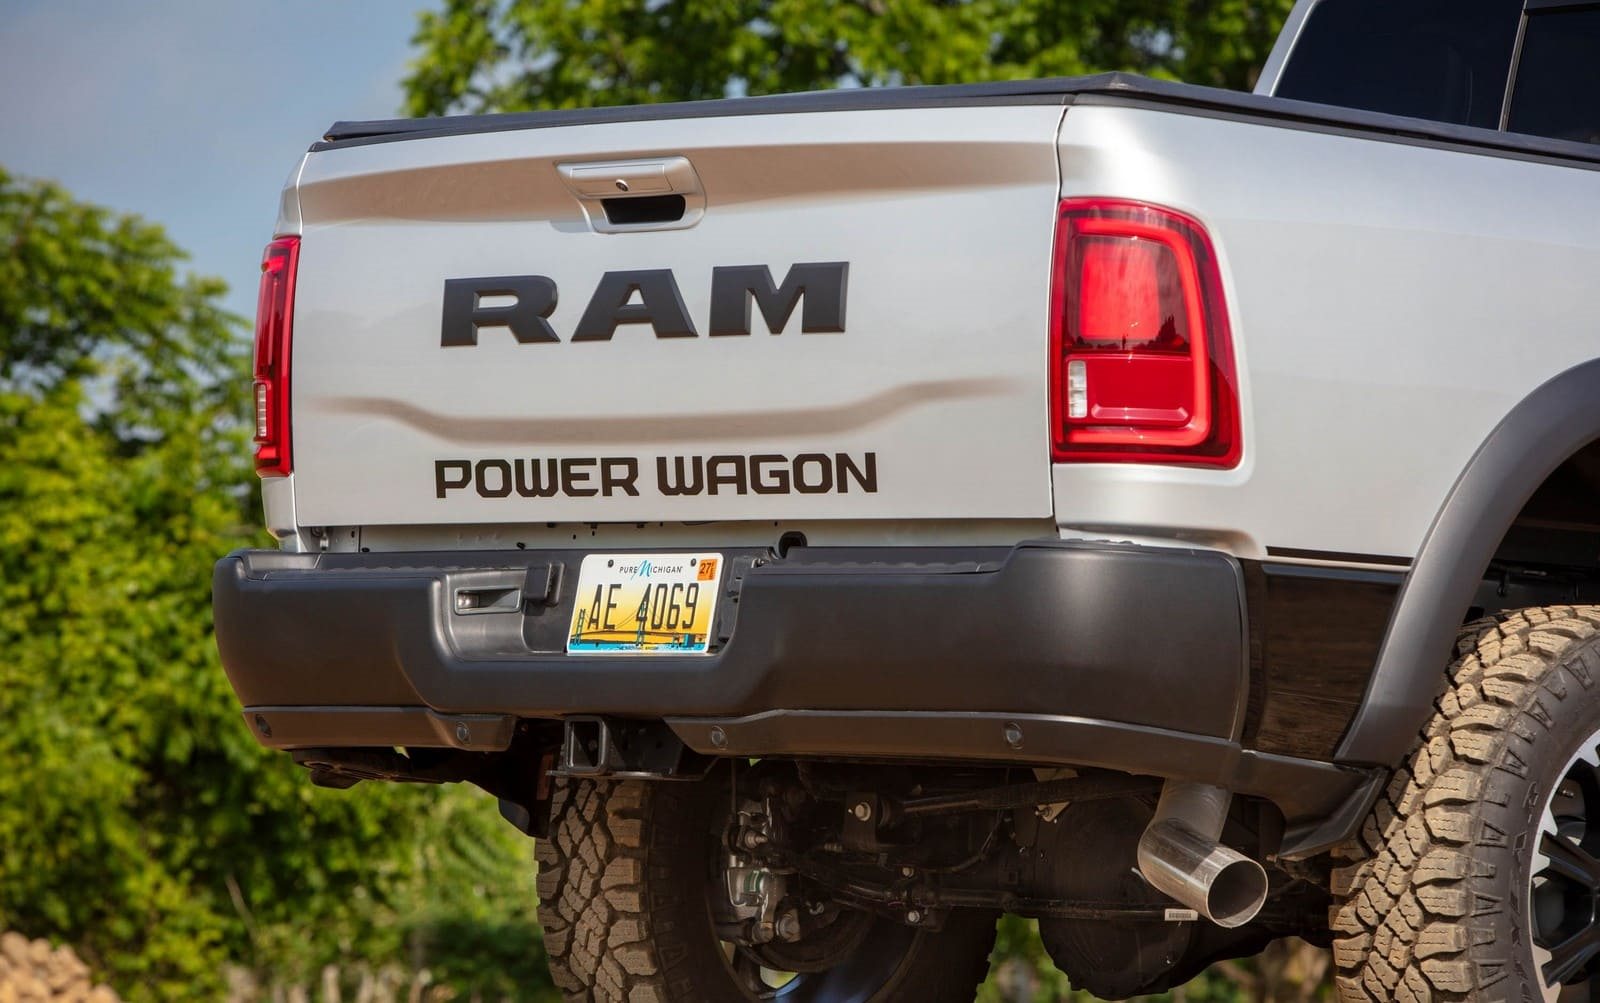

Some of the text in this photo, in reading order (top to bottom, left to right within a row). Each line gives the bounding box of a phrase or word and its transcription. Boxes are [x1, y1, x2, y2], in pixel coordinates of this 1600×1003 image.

[440, 261, 850, 347] RAM
[434, 452, 878, 499] POWER WAGON
[619, 560, 683, 579] PURE MICHIGAN
[699, 562, 712, 575] 27
[588, 583, 699, 630] AE 4069
